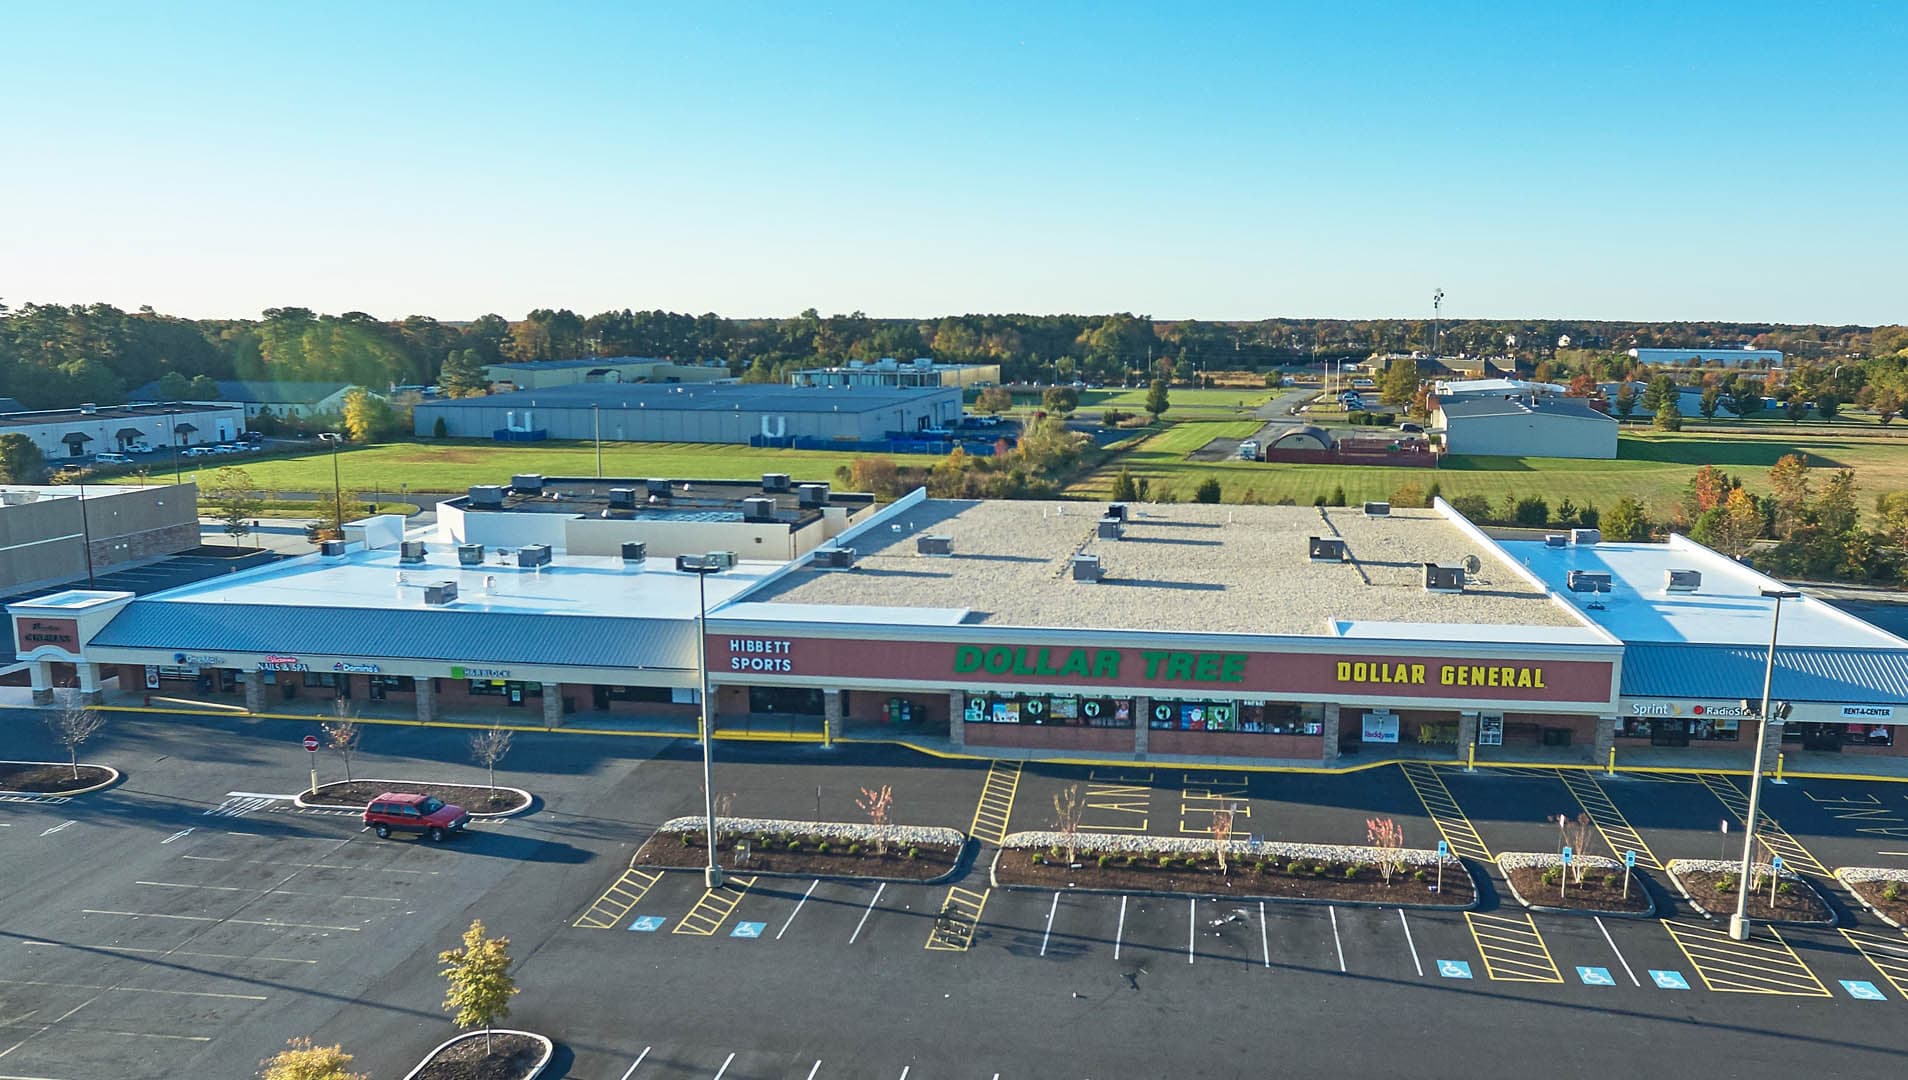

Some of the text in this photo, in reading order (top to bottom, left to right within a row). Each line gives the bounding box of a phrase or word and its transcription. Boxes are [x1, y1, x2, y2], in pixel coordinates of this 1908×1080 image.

[730, 640, 791, 653] HIBBETT
[257, 662, 281, 672] NAILS
[291, 663, 309, 672] SPA
[731, 657, 791, 671] SPORTS
[954, 644, 1249, 682] DOLLAR TREE
[1337, 662, 1545, 688] DOLLAR GENERAL
[1632, 703, 1668, 716] Sprint
[1706, 707, 1748, 716] RadioS
